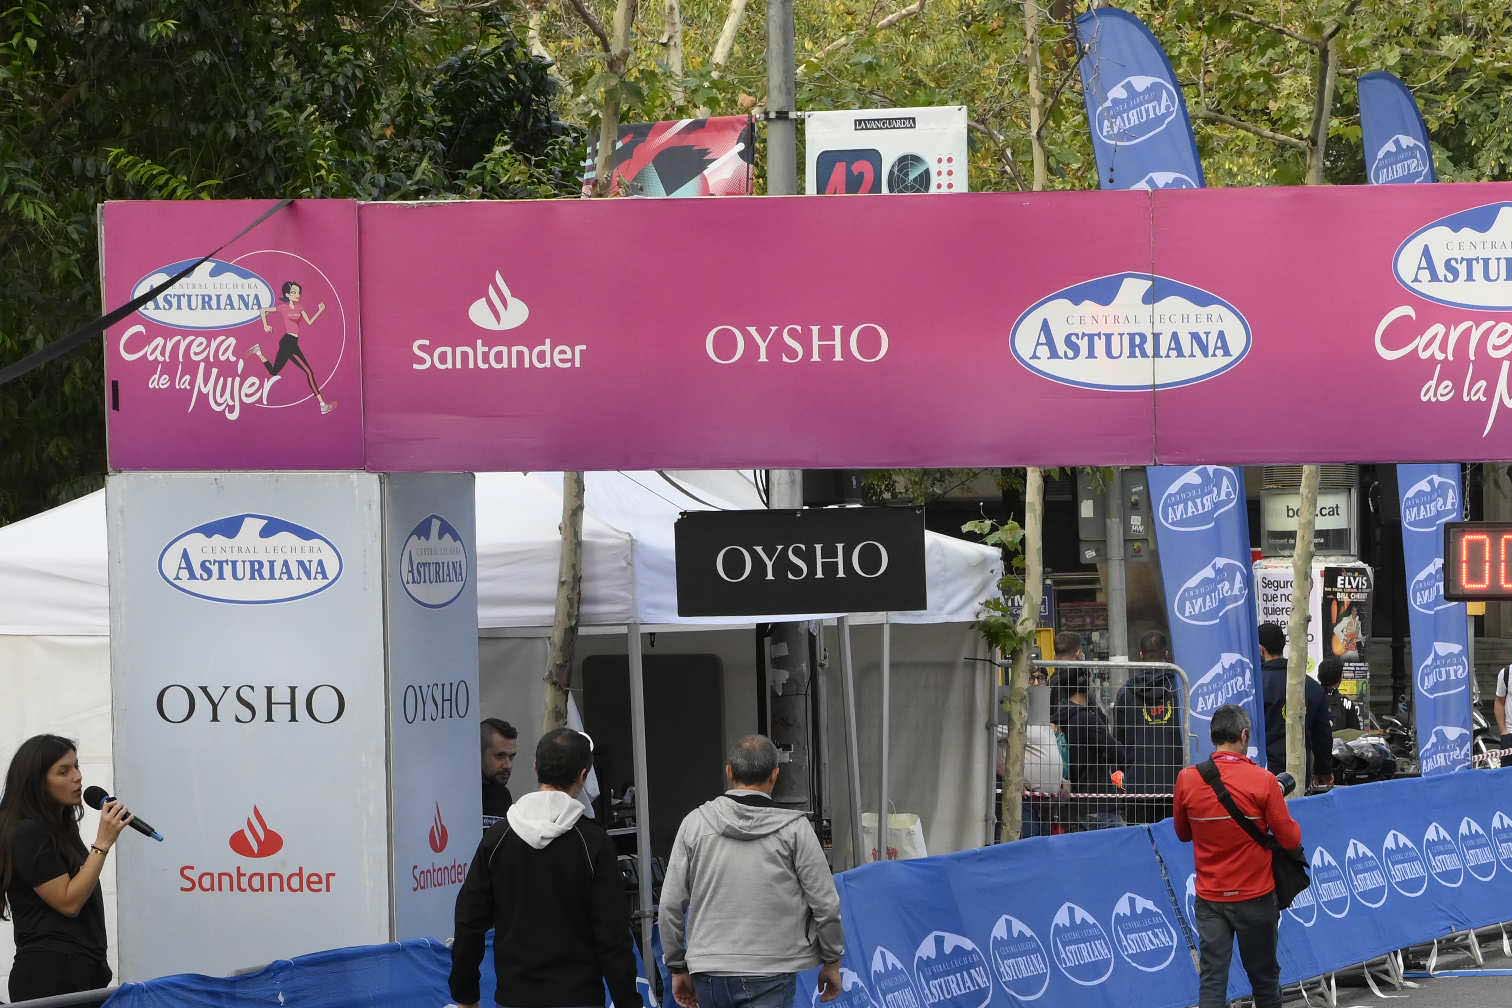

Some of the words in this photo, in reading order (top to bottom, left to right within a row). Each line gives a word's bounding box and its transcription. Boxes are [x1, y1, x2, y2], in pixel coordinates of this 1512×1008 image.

[1066, 315, 1140, 325] CENTRAL
[1149, 312, 1224, 324] LECHERA
[119, 325, 237, 362] Carrera
[412, 339, 586, 370] Santander
[705, 323, 889, 364] OYSHO
[1029, 318, 1233, 360] ASTURIANA
[149, 365, 170, 390] de
[176, 362, 190, 390] la
[188, 358, 282, 420] Mujer
[1420, 365, 1455, 402] de
[1463, 363, 1487, 402] la
[173, 548, 329, 581] ASTURIANA
[201, 545, 258, 554] CENTRAL
[265, 545, 322, 554] LECHERA
[406, 549, 464, 585] ASTURIANA
[716, 541, 889, 582] OYSHO
[1337, 576, 1367, 588] ELVIS
[156, 684, 346, 724] OYSHO
[403, 680, 470, 725] OYSHO
[179, 865, 335, 893] Santander
[412, 858, 468, 892] Santander
[1000, 950, 1046, 983] ASTURIANA
[1059, 938, 1113, 968] ASTURIANA
[921, 966, 990, 1003] ASTURIANA
